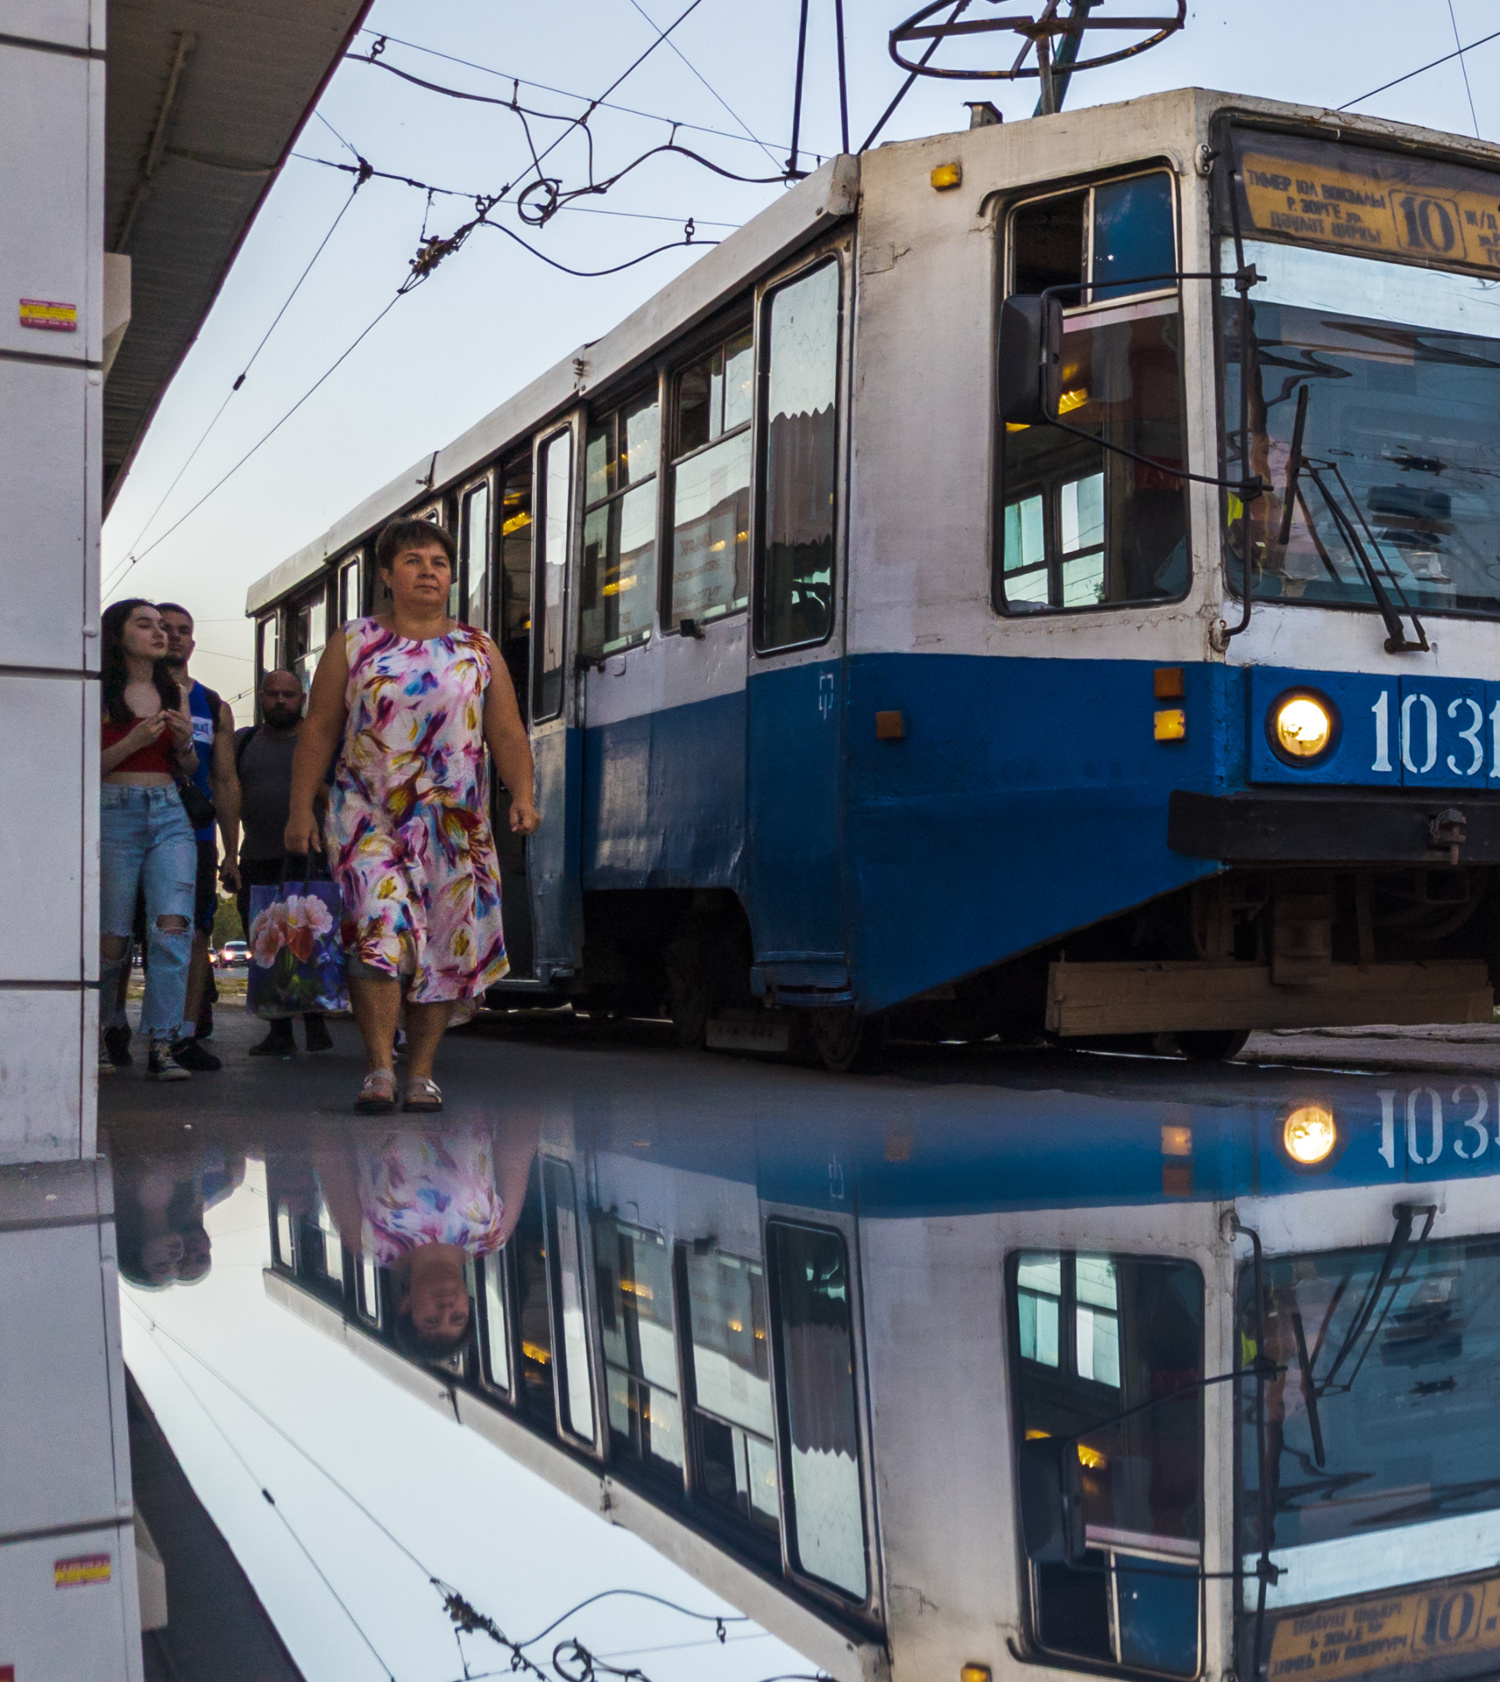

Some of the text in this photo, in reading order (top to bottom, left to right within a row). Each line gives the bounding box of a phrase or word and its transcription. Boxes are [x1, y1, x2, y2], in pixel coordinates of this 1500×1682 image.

[1246, 169, 1386, 210] ТИМЕР ЮЛ ВОКЗАЛЫ
[1300, 198, 1342, 219] ЗОРГЕ
[1399, 195, 1455, 252] 10
